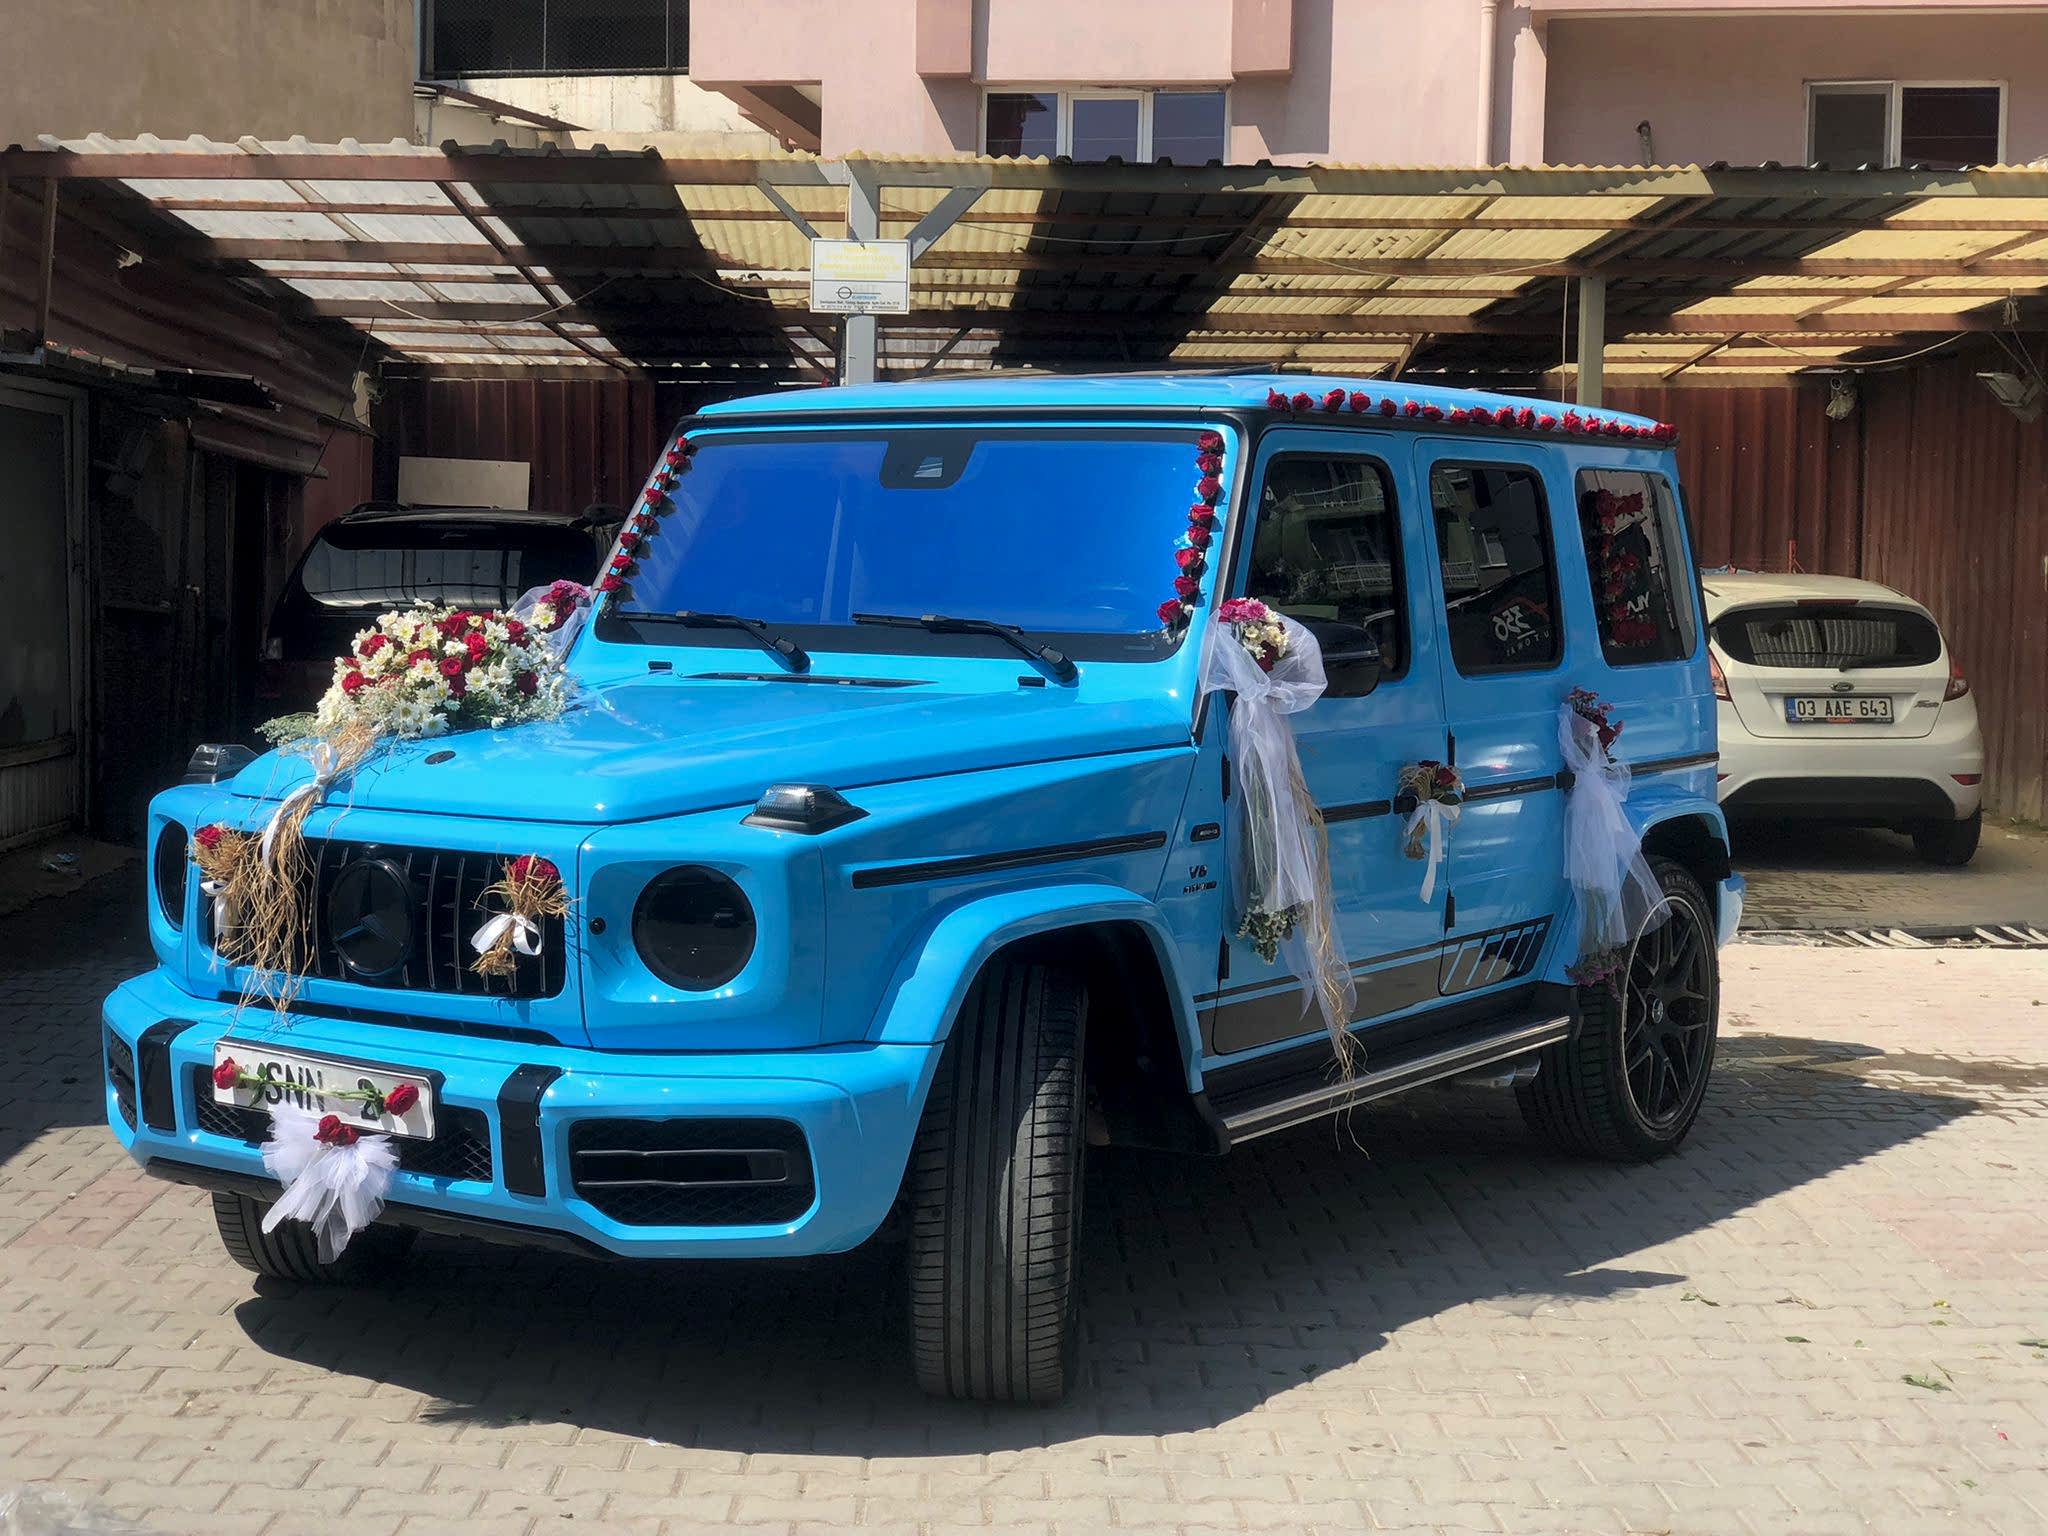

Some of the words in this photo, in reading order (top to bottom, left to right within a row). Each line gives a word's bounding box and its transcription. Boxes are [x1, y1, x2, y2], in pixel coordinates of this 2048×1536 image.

[1797, 700, 1816, 716] 03
[1825, 700, 1853, 716] AAE
[1860, 700, 1888, 716] 643
[265, 1061, 325, 1112] SNN
